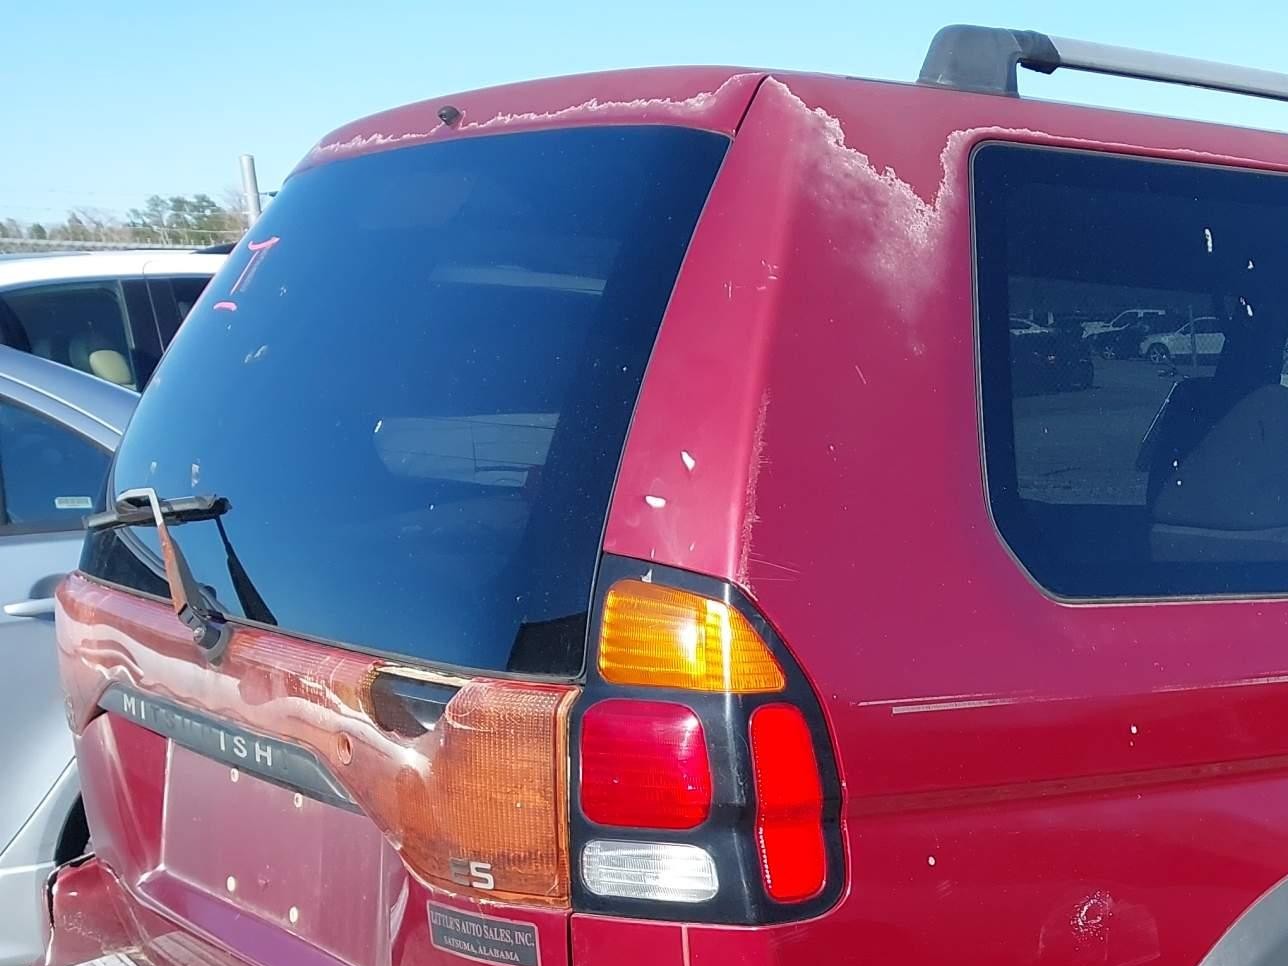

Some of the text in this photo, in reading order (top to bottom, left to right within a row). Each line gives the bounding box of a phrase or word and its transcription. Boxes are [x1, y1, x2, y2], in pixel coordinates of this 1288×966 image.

[430, 910, 535, 947] LITTLE'S AUTO SALES, INC.
[443, 935, 520, 961] SATSUMA, ALABAMA
